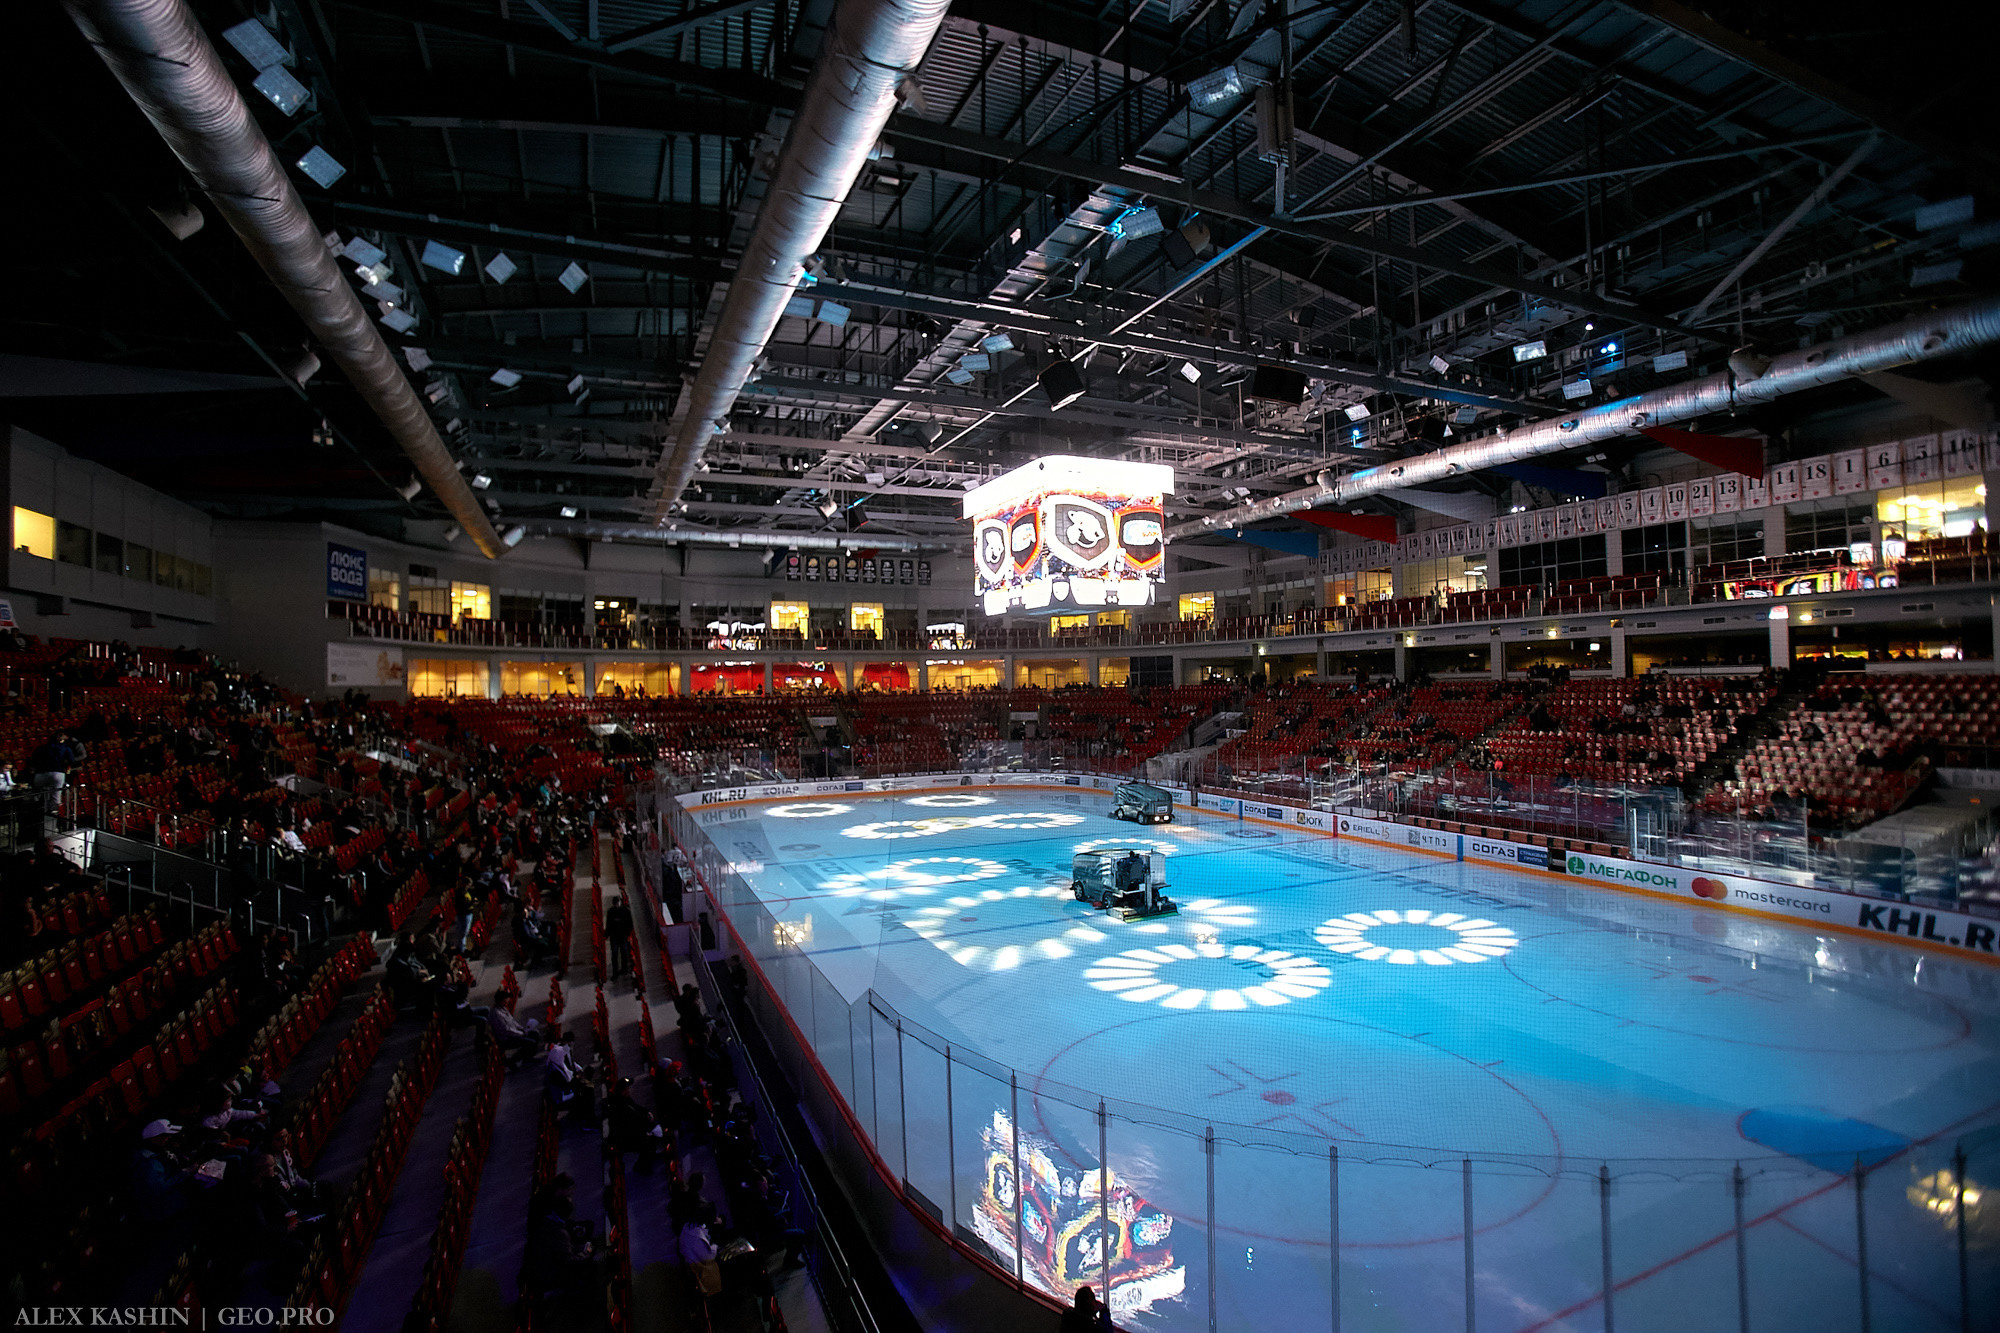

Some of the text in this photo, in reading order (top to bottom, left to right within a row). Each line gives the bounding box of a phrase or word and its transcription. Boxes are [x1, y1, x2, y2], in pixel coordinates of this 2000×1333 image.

[1916, 444, 1928, 460] 5
[1846, 459, 1853, 473] 1
[1879, 452, 1889, 467] 6
[1807, 464, 1827, 480] 18
[1693, 484, 1710, 499] 21
[1720, 480, 1736, 495] 13
[1669, 490, 1684, 504] 10
[1625, 498, 1632, 511] 5
[1409, 538, 1418, 548] 19
[1425, 536, 1431, 545] 9
[1438, 533, 1448, 544] 13
[1454, 530, 1464, 542] 16
[816, 784, 844, 792] СОГАЗ
[701, 788, 747, 804] KHL.RU
[1244, 805, 1266, 815] СОГАЗ
[1306, 817, 1323, 827] ЮГК
[1353, 824, 1380, 835] ERIELL
[1472, 843, 1515, 858] СОГАЗ
[1589, 862, 1677, 889] МЕГАФОН
[1735, 887, 1831, 914] mastercard
[1859, 902, 2000, 952] KHL.R
